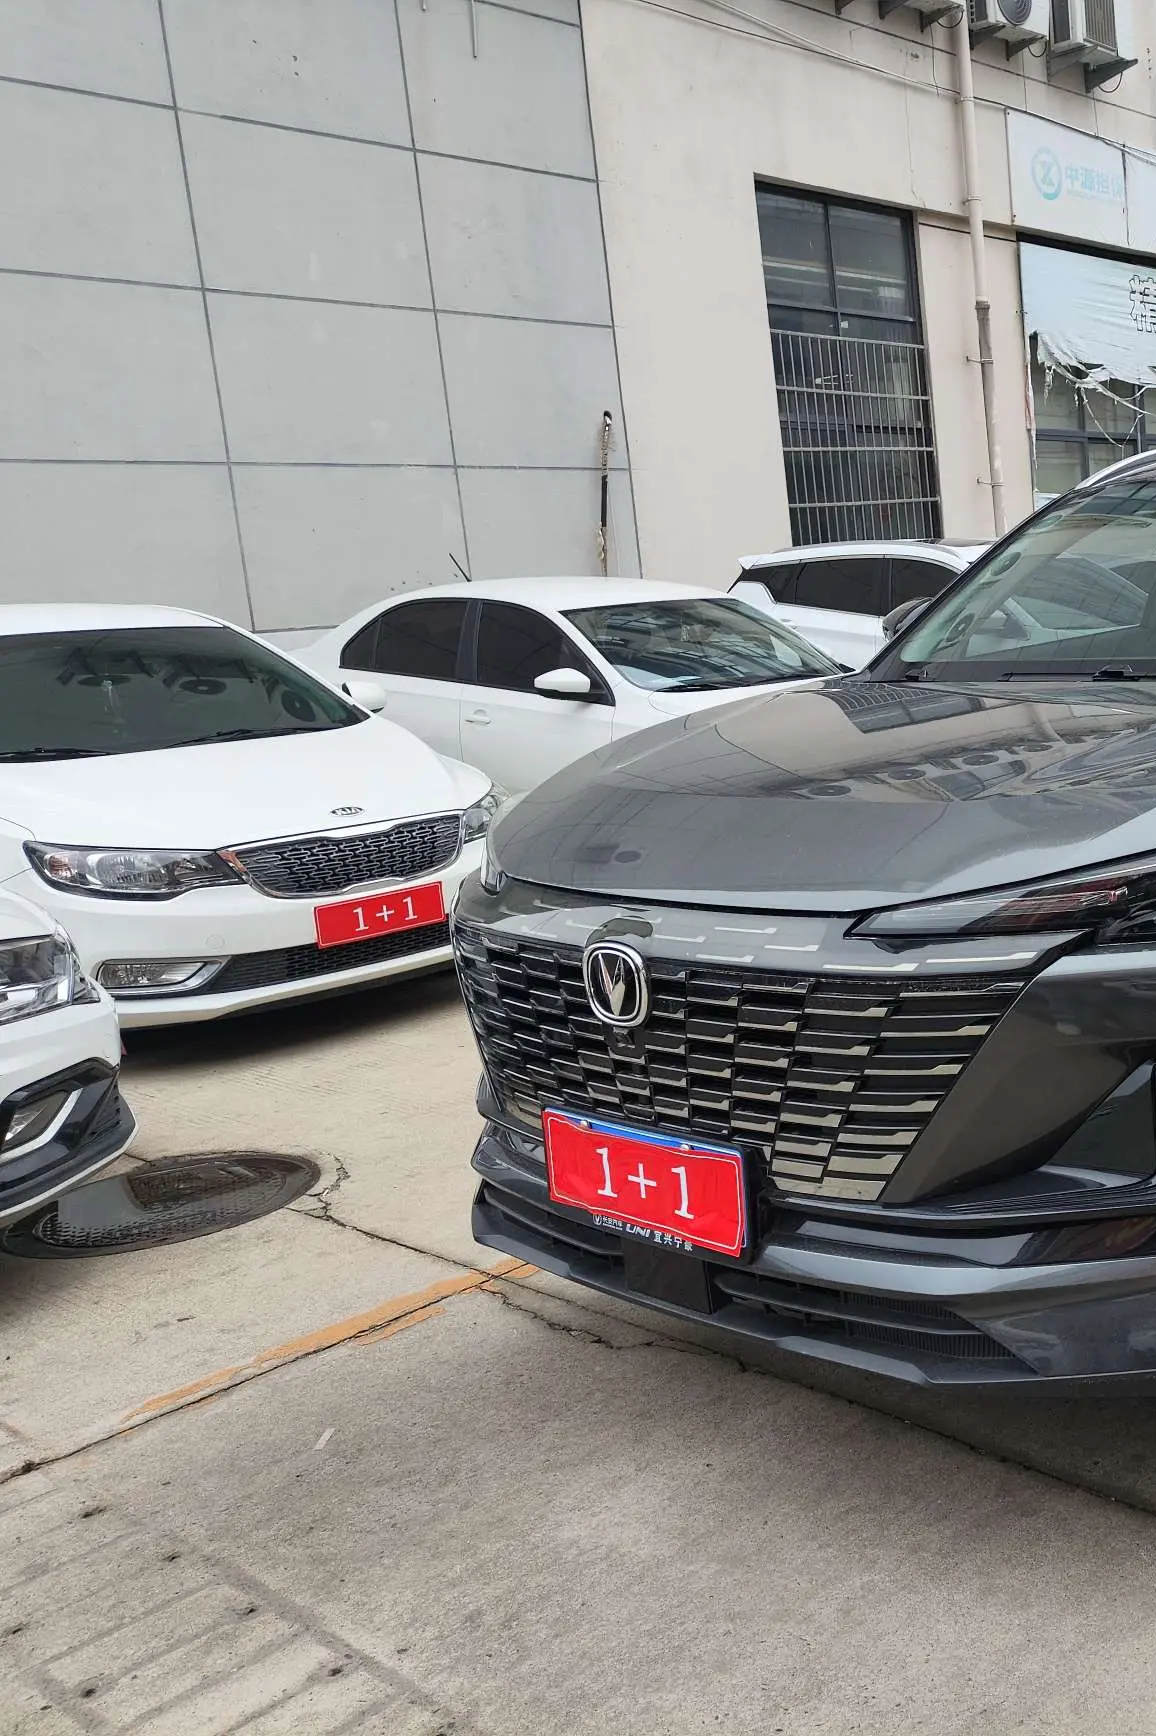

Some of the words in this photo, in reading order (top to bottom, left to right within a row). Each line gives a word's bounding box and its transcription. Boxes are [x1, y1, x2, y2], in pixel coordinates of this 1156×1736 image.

[353, 896, 418, 932] 1+1
[596, 1147, 694, 1220] 1+1
[625, 1223, 651, 1238] UNI
